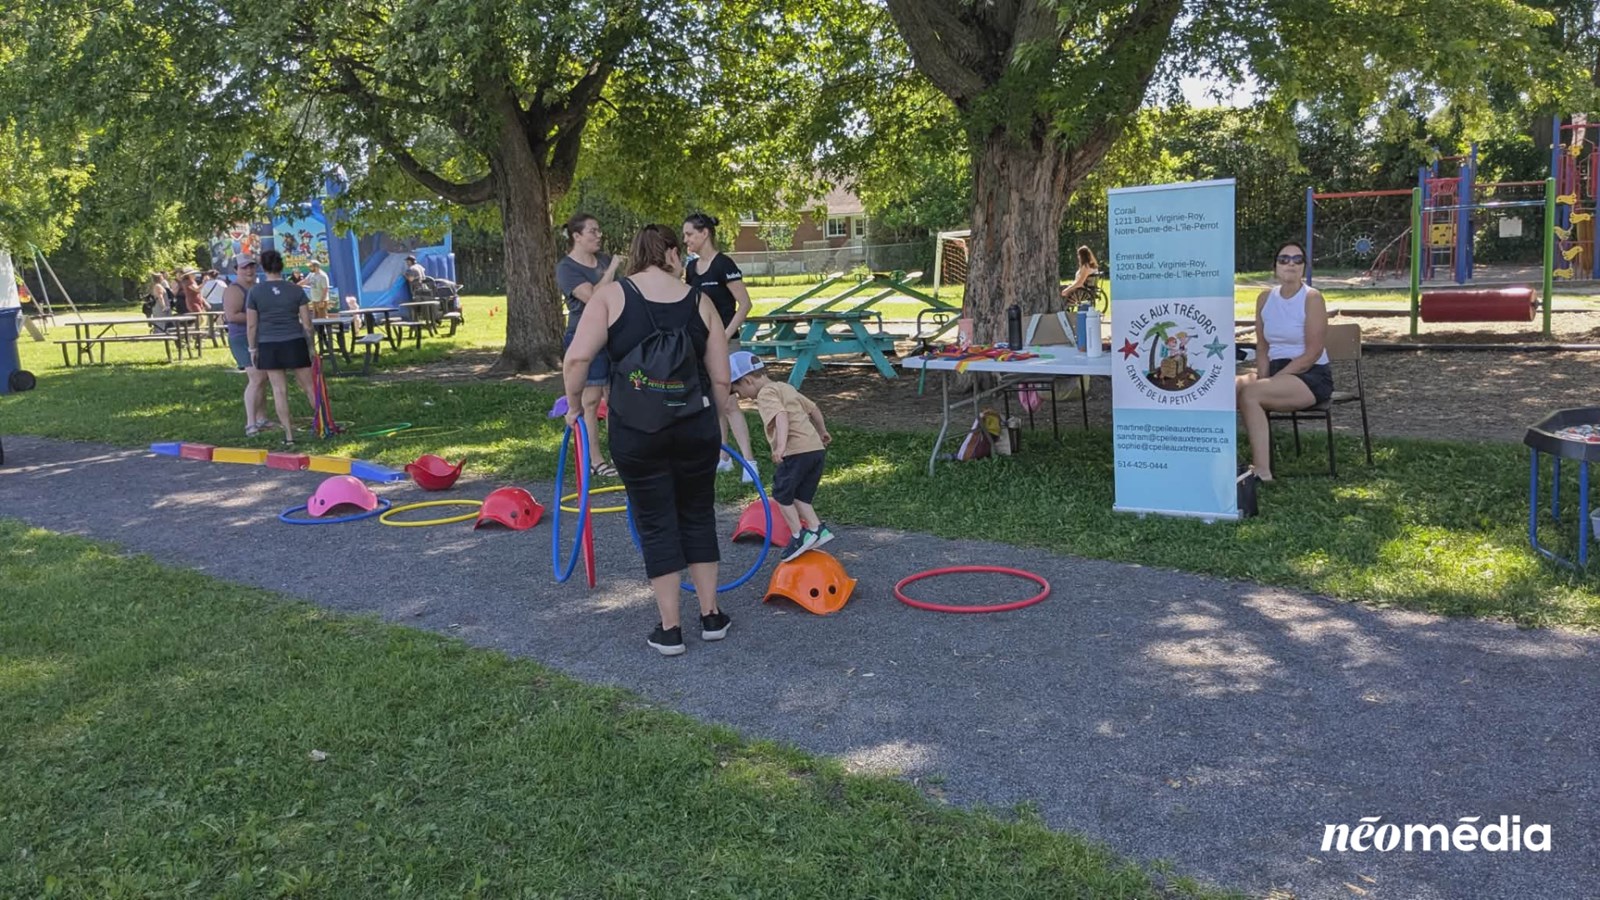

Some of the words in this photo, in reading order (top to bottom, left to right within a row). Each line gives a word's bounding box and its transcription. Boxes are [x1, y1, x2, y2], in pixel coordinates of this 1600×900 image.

[1114, 206, 1136, 216] Corail
[1115, 217, 1133, 226] 1211
[1116, 251, 1155, 261] Émeraude
[1116, 262, 1135, 272] 1200
[1129, 313, 1150, 337] L'ÎLE
[1149, 303, 1170, 320] AUX
[1173, 303, 1217, 335] TRÉSORS
[1126, 364, 1148, 392] CENTRE
[1146, 388, 1156, 401] DE
[1158, 394, 1167, 405] LA
[1169, 392, 1198, 405] PETITE
[1197, 363, 1222, 397] ENFANCE
[1117, 460, 1168, 470] 514-425-0444
